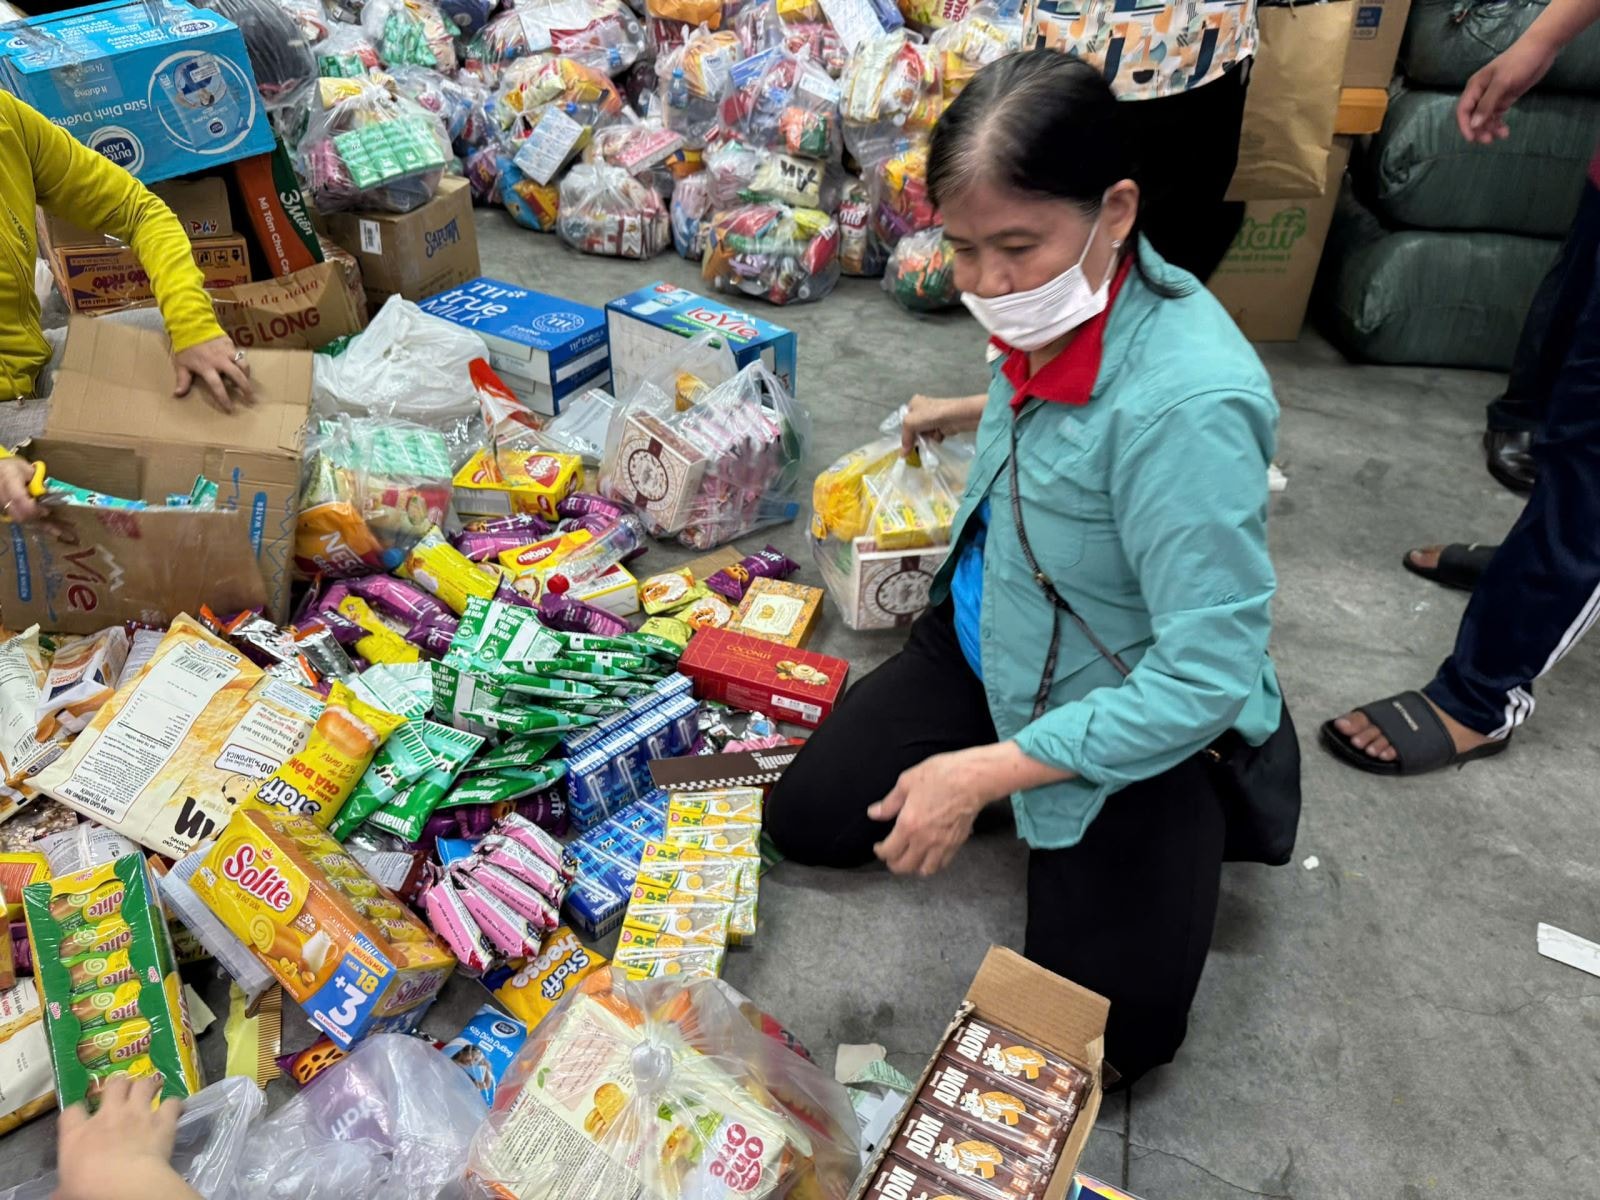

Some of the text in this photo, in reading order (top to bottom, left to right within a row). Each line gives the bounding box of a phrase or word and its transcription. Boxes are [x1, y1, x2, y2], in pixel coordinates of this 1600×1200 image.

[95, 105, 123, 119] Dinh
[124, 99, 147, 111] Sữa
[102, 142, 125, 153] LADY
[106, 149, 131, 160] DUTC
[1236, 207, 1306, 252] taff
[440, 290, 508, 316] true
[469, 282, 507, 299] TH
[257, 307, 320, 342] LONG
[420, 300, 491, 325] MILK
[726, 644, 772, 659] COCONUT
[226, 752, 255, 764] JAPONICA
[254, 776, 321, 816] Staff
[223, 844, 292, 912] Solite
[88, 891, 122, 916] olite
[95, 931, 130, 954] olite
[512, 933, 577, 988] heese
[103, 966, 134, 985] lite
[355, 968, 379, 994] 18
[541, 948, 590, 1001] Staff
[111, 1000, 137, 1020] lite
[116, 1035, 150, 1059] olite
[480, 1032, 494, 1044] Dinh
[493, 1040, 514, 1058] Dưỡng
[956, 1022, 991, 1062] ADM
[932, 1066, 969, 1108] ADM
[906, 1114, 944, 1159] ADM
